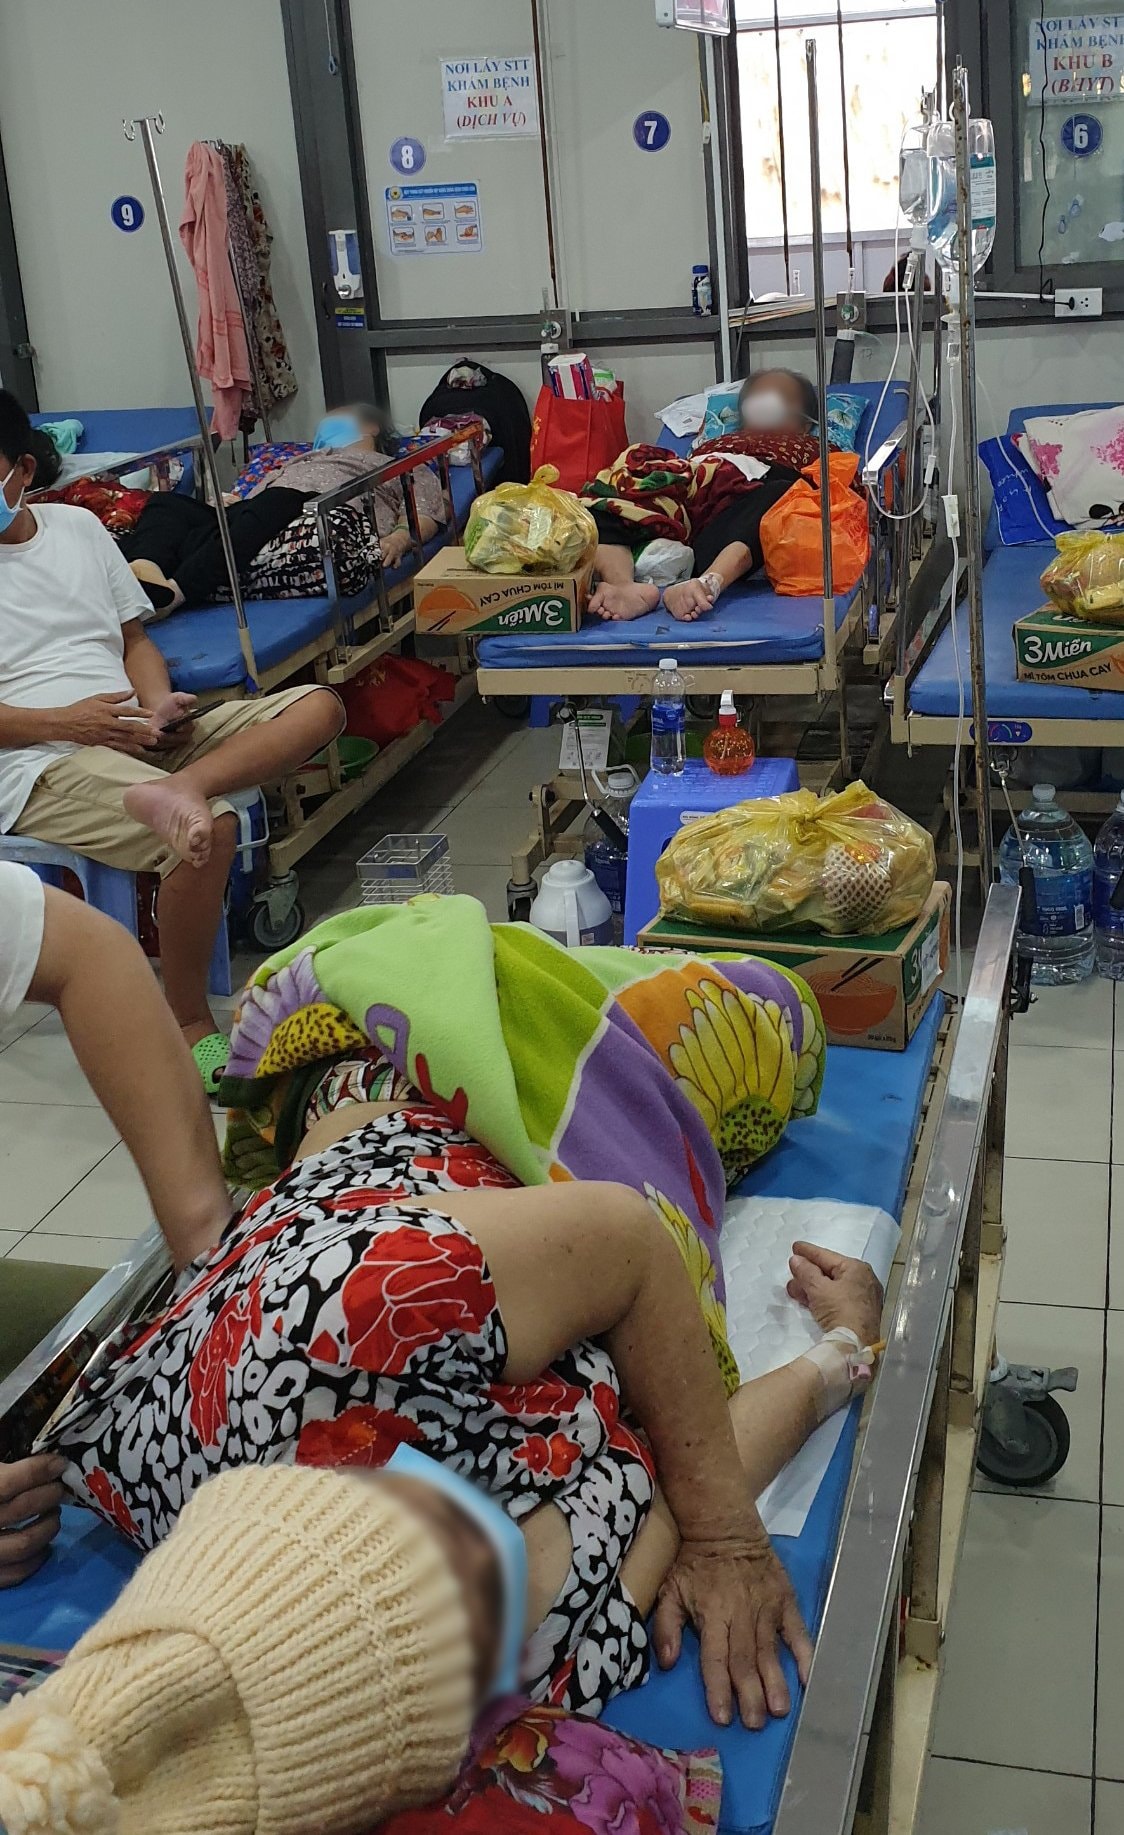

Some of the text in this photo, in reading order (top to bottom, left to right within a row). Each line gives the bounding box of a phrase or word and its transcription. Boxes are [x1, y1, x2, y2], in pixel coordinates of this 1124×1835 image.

[1102, 16, 1124, 30] ST
[1036, 34, 1083, 51] KHÁM
[445, 57, 530, 75] NƠI LẤY STT
[1053, 53, 1113, 71] KHU B
[447, 75, 530, 92] KHÁM BỆNH
[1051, 76, 1115, 96] (BHYT)
[467, 95, 513, 109] KHU A
[456, 111, 527, 130] (DỊCH VỤ)
[644, 120, 658, 145] 7
[1073, 123, 1089, 149] 6
[401, 145, 414, 169] 8
[121, 204, 134, 227] 9
[479, 581, 564, 607] MÌ TÔM CHUA CAY
[1036, 672, 1055, 681] TÔM
[1056, 669, 1089, 681] CHUA
[1088, 662, 1112, 676] CAY
